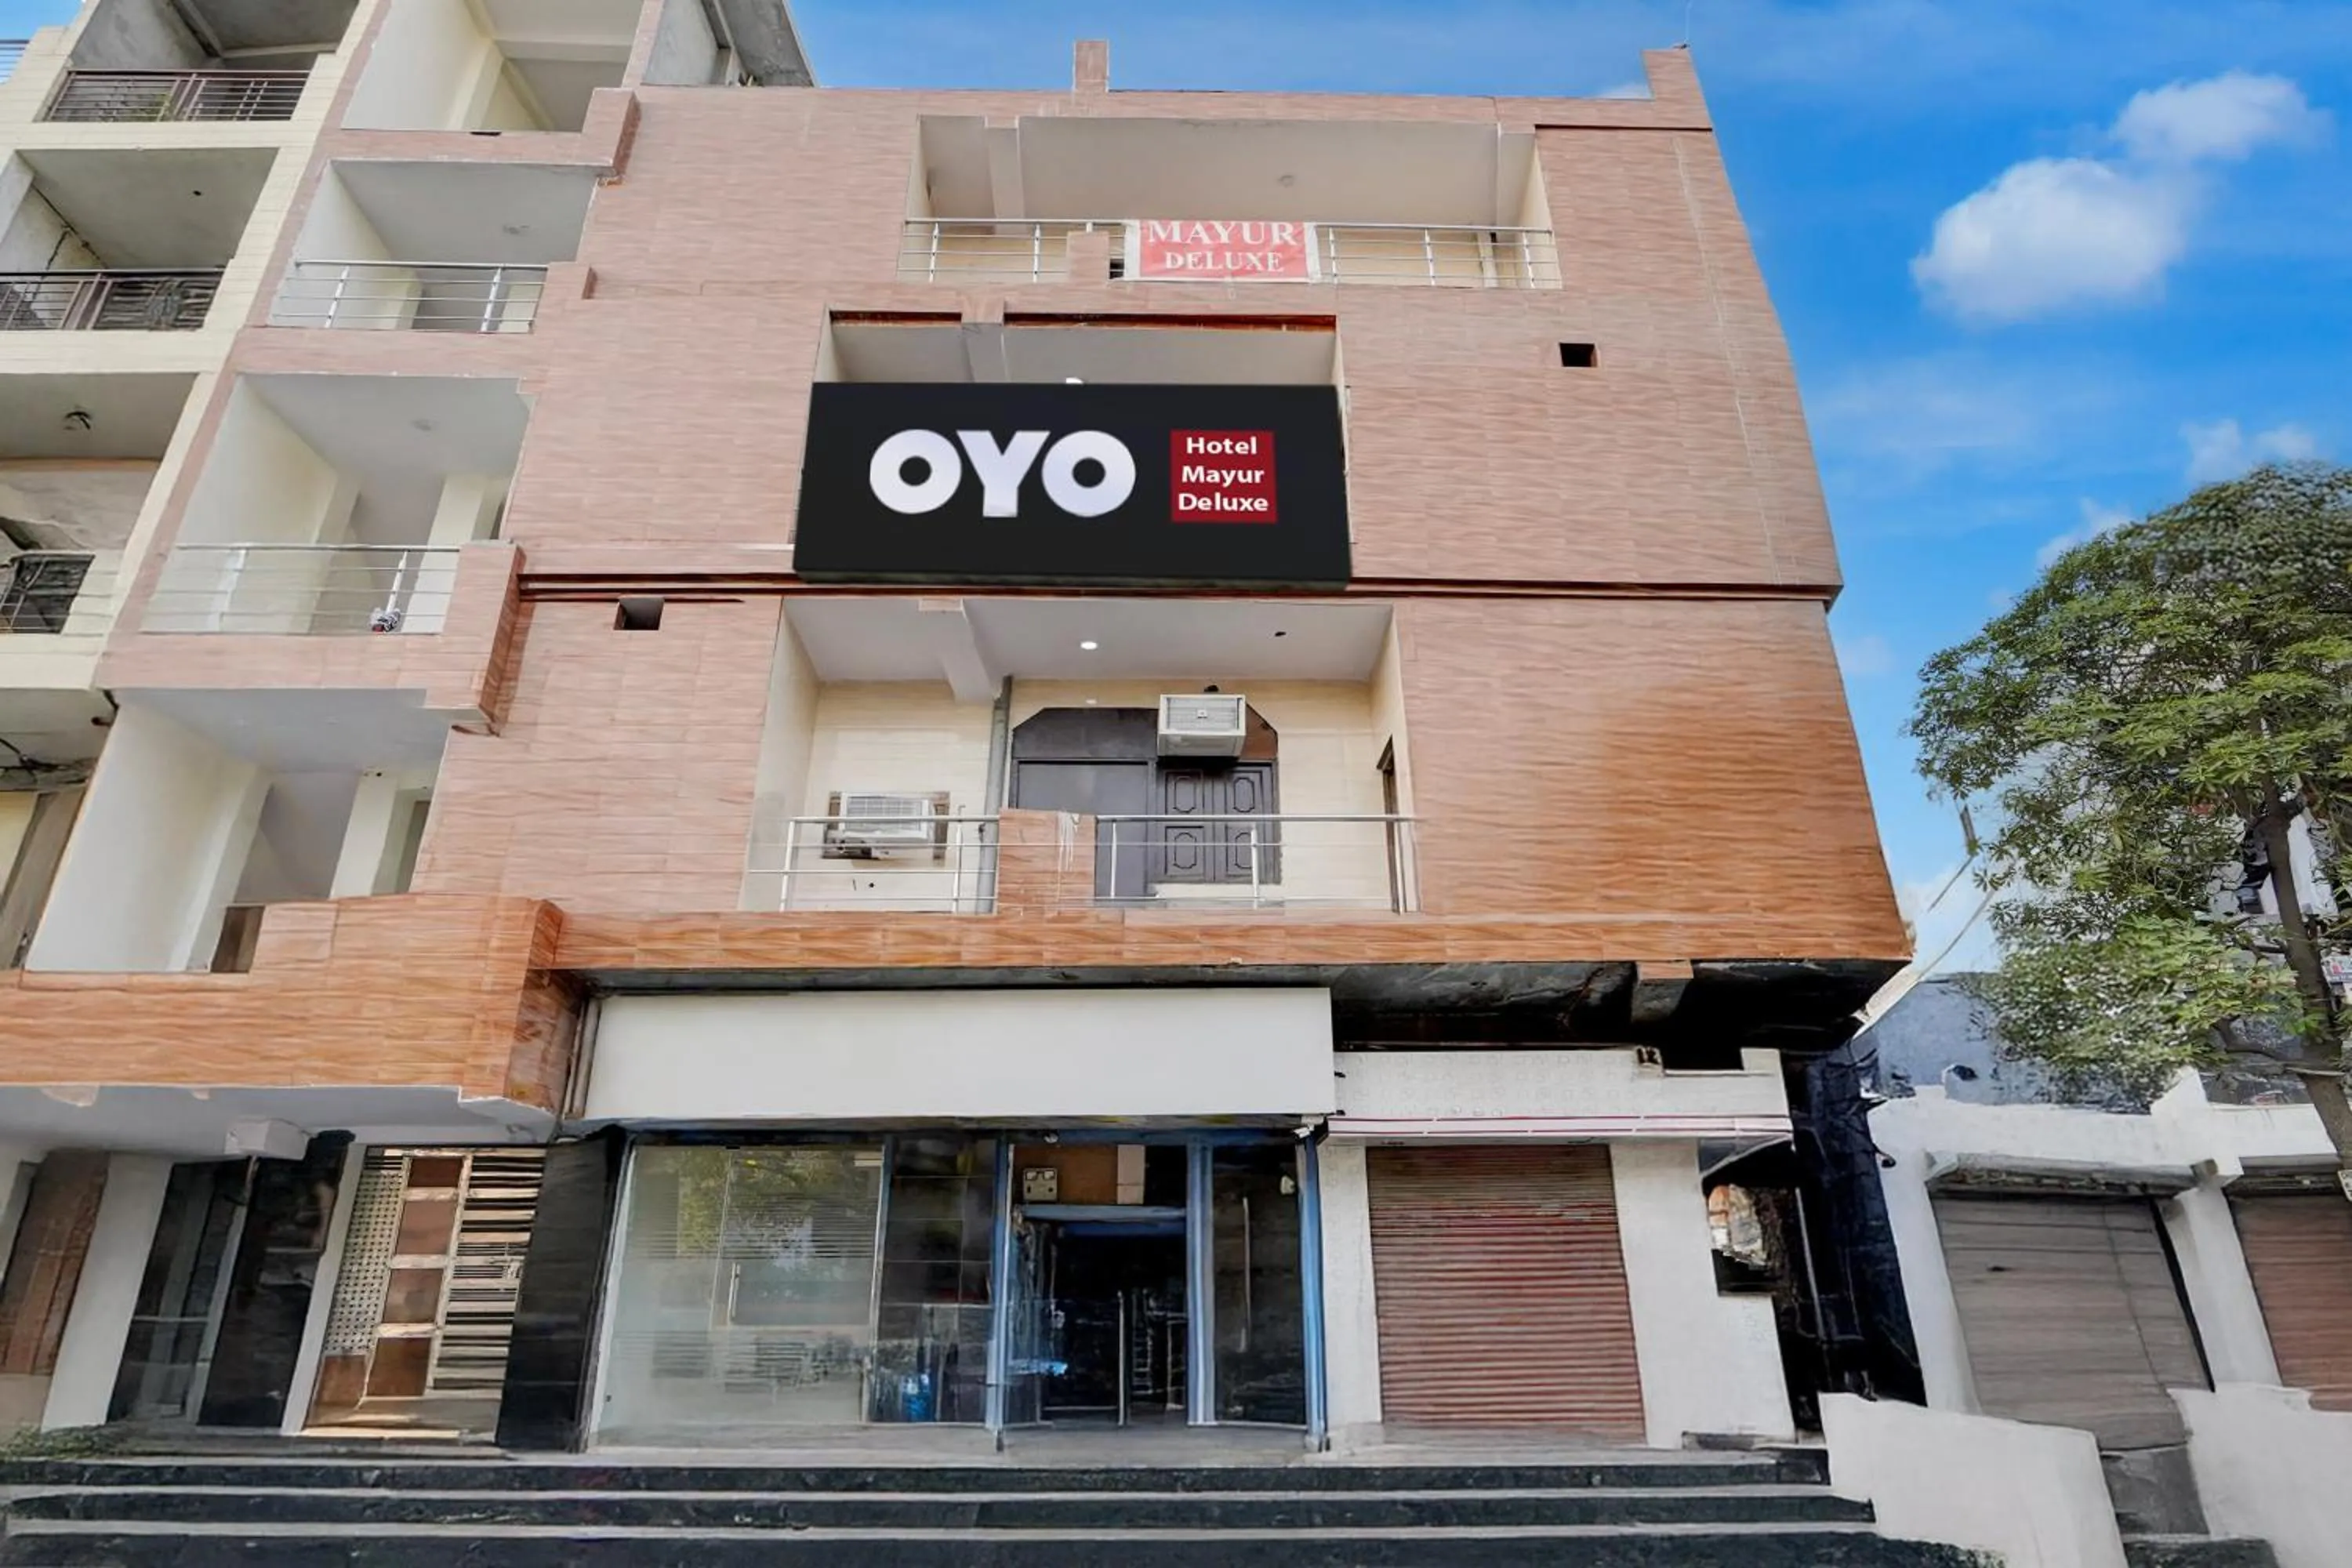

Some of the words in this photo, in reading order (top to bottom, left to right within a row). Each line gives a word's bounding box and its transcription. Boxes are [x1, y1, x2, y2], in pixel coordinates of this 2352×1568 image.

[1148, 220, 1297, 245] MAYUR
[1166, 251, 1283, 272] DELUXE
[1186, 436, 1257, 455] Hotel
[869, 429, 1136, 517] OYO
[1181, 465, 1265, 488] Mayur
[1178, 492, 1269, 511] Deluxe
